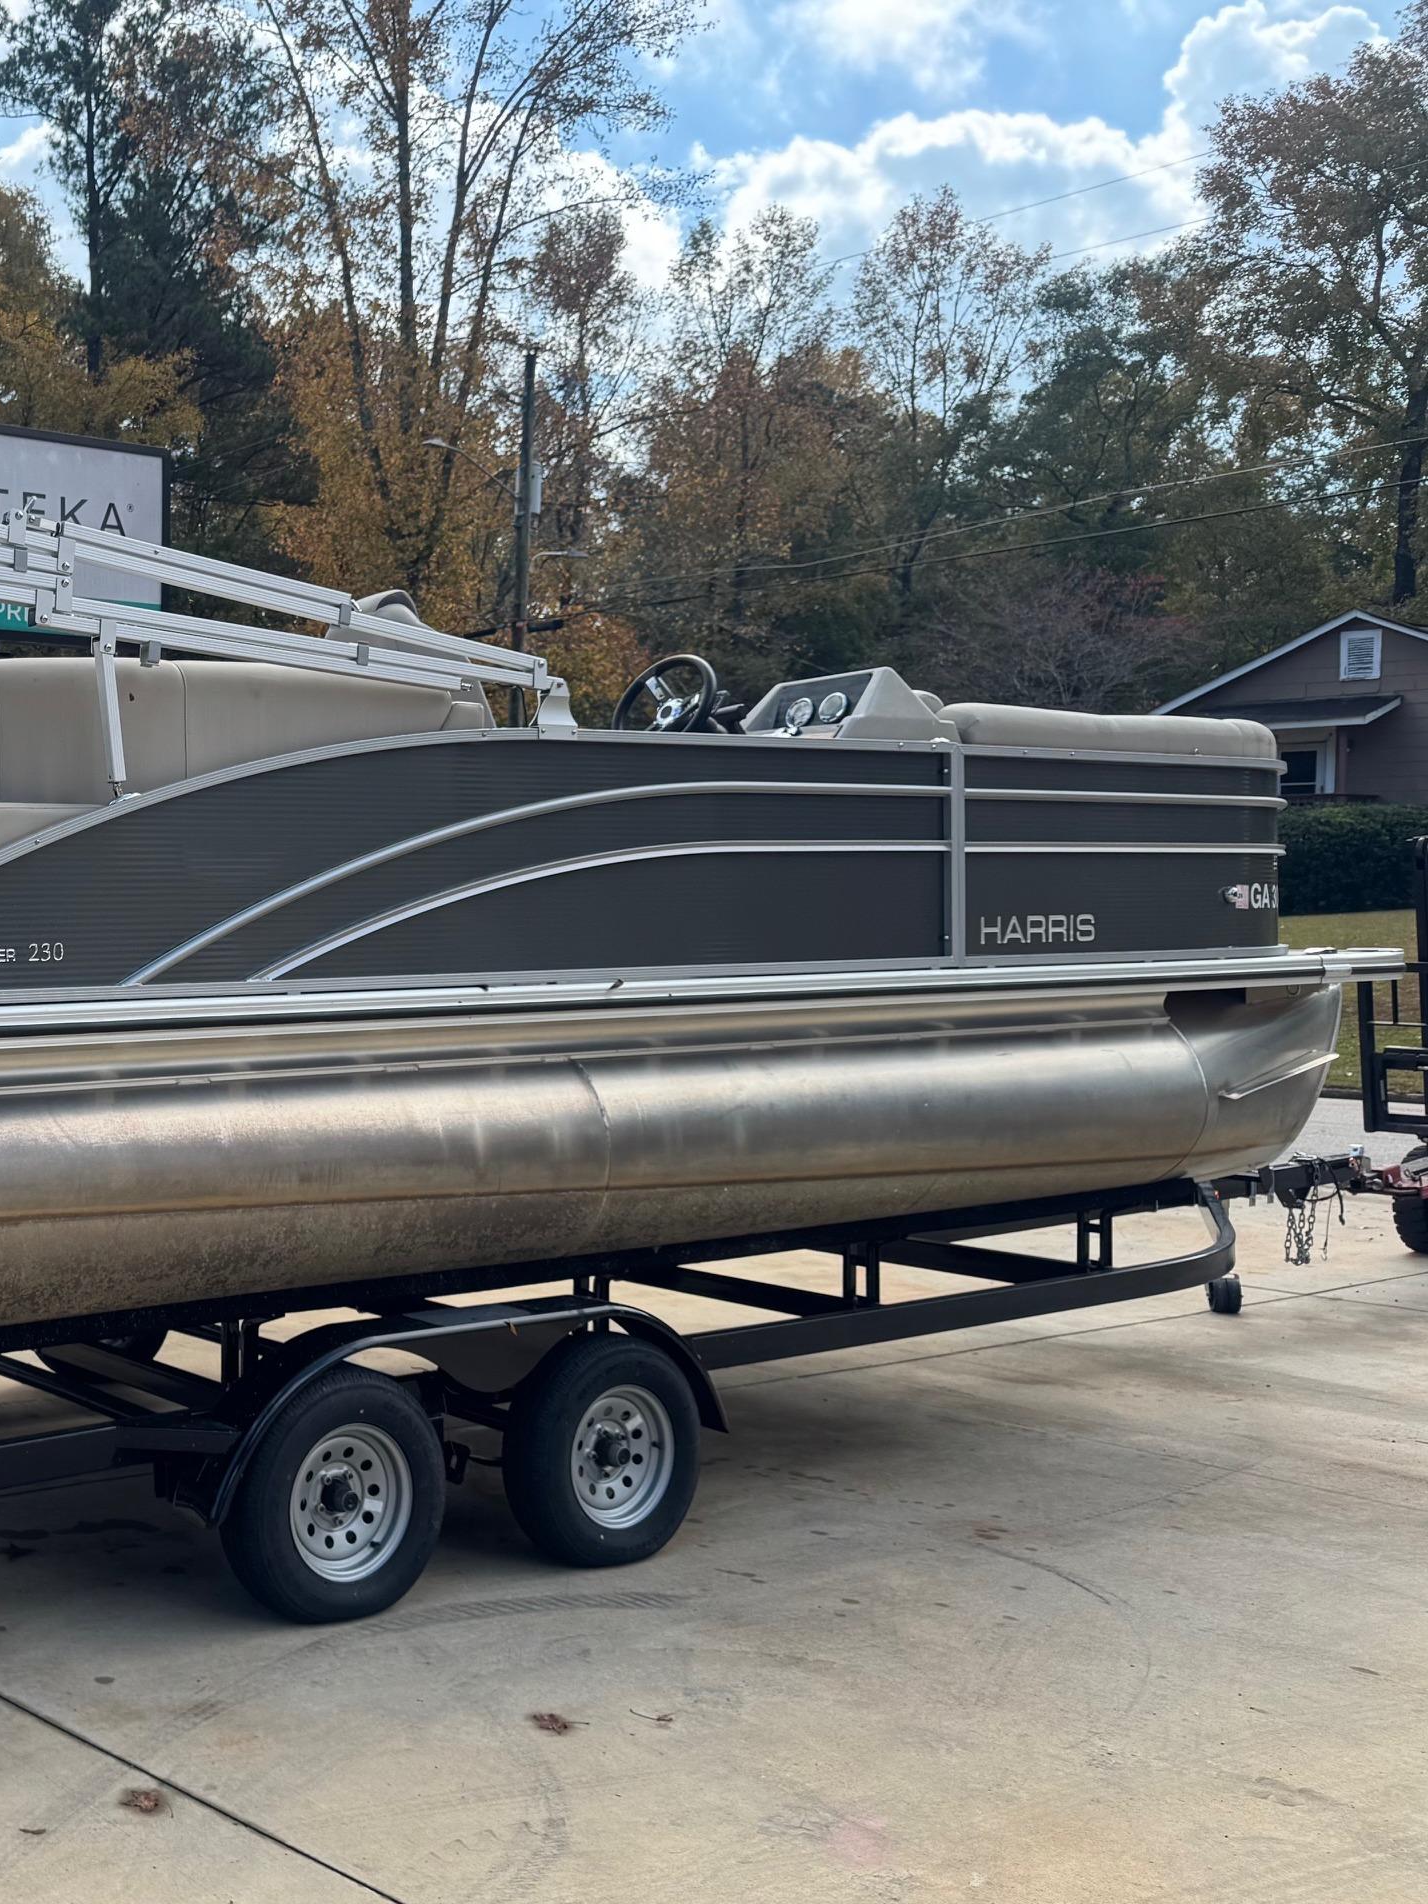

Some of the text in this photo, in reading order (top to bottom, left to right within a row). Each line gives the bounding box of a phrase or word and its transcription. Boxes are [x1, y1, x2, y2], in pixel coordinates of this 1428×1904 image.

[1251, 882, 1271, 909] GA
[980, 913, 1096, 945] HARRIS
[28, 942, 64, 962] 230
